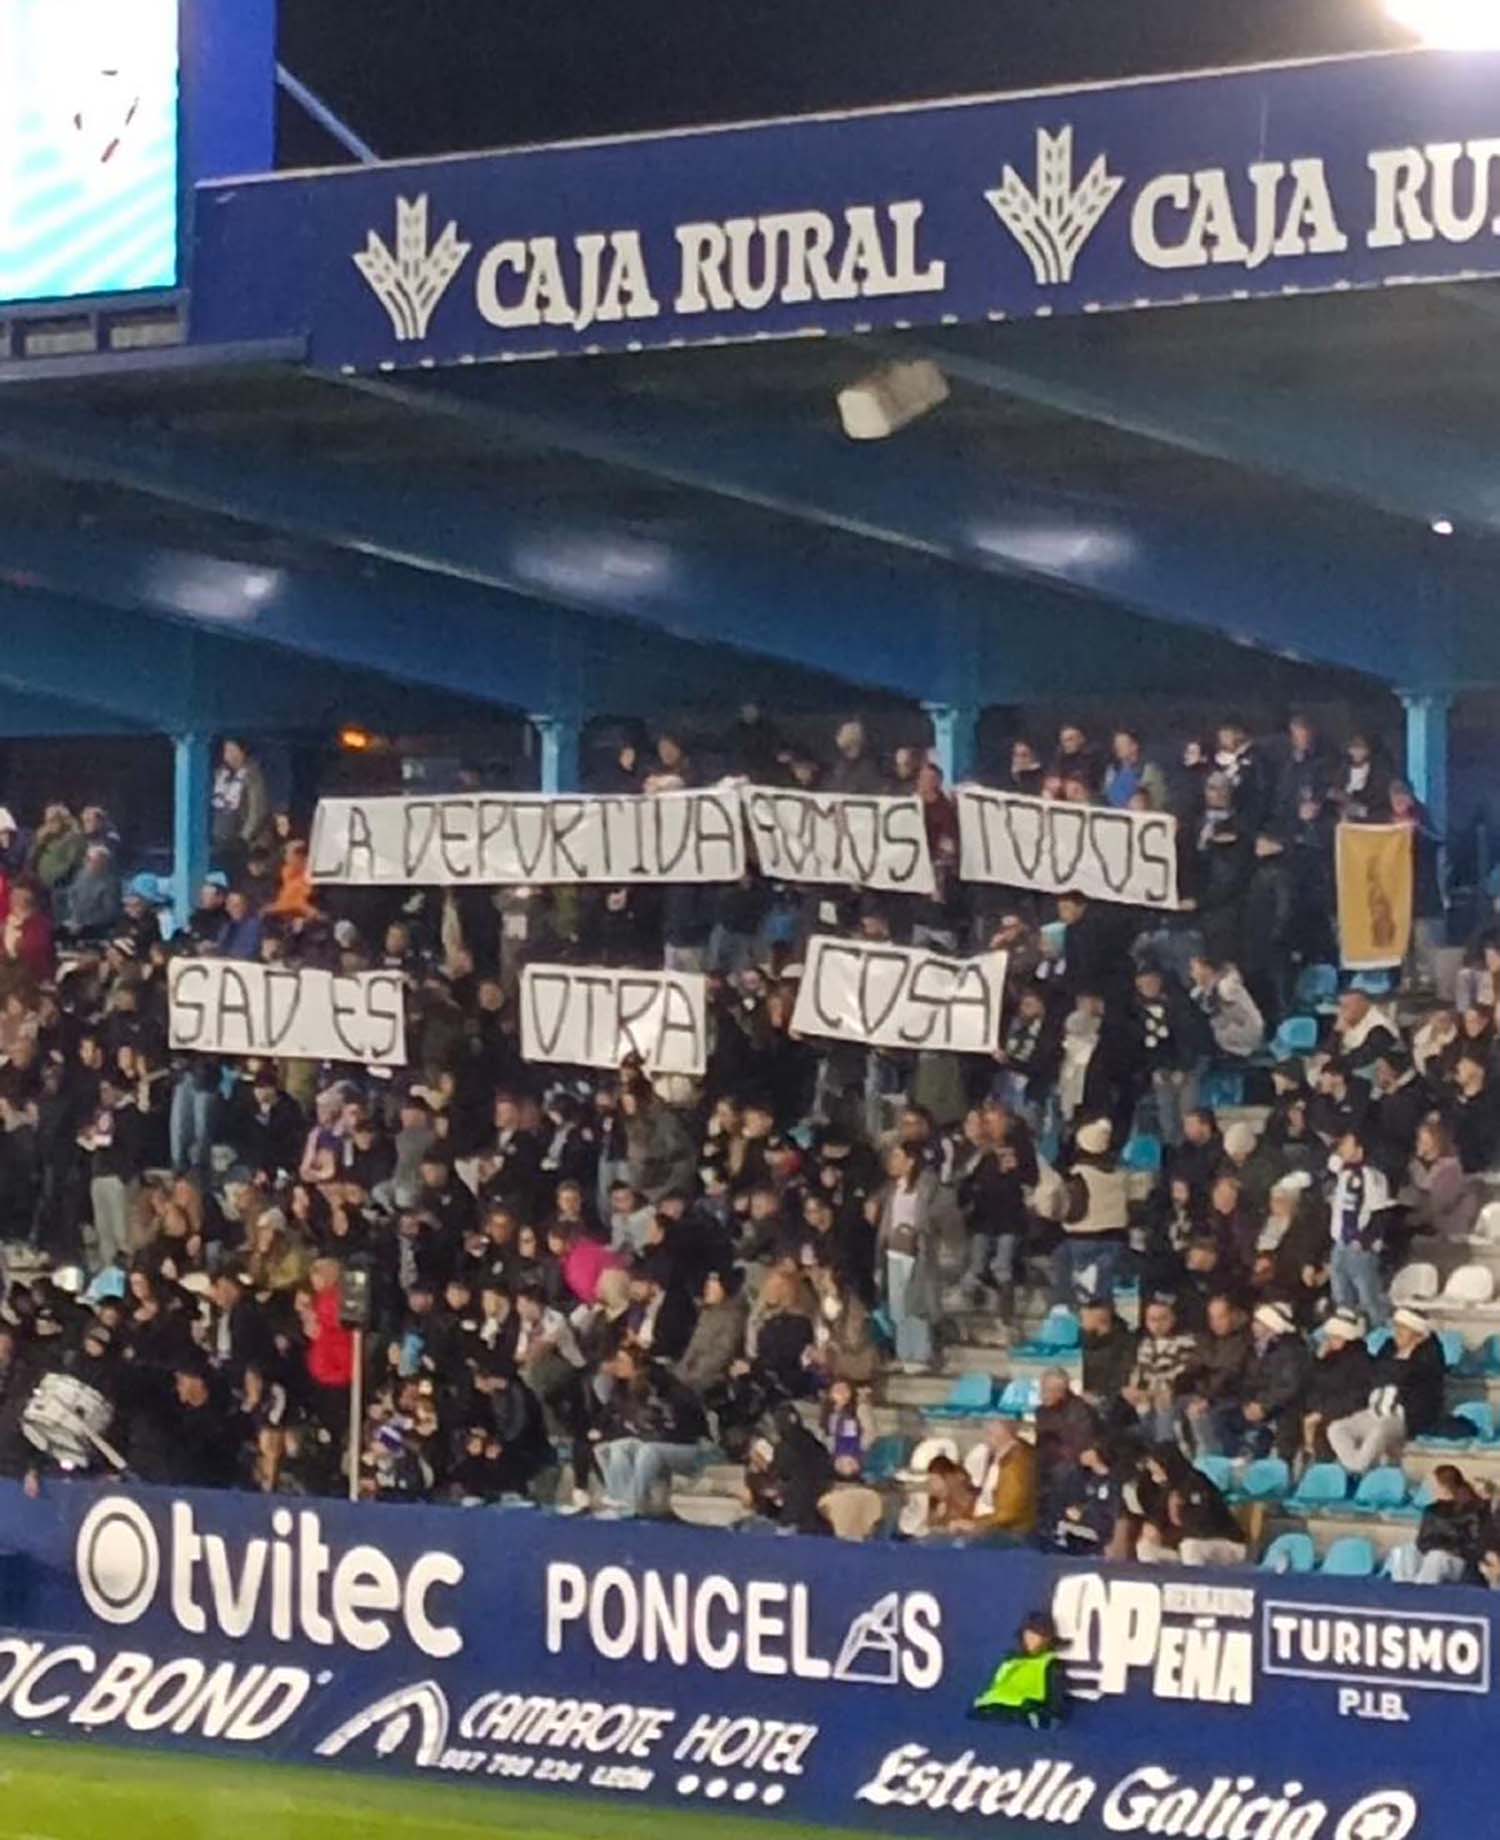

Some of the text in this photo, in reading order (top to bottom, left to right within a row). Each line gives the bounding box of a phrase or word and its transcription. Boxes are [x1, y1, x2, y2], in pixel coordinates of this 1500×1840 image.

[1131, 136, 1500, 269] CAJA RU
[477, 201, 945, 332] CAJA RURAL
[310, 795, 738, 879] LA DEPORTIVA
[964, 793, 1169, 901] TODOS
[328, 972, 398, 1059] ES
[529, 974, 700, 1069] OTRA
[813, 943, 992, 1045] COSA
[172, 1501, 464, 1659] tvitec
[546, 1562, 944, 1690] PONCELAS
[1271, 1614, 1480, 1676] TURISMO
[459, 1690, 819, 1776] CAMAROTE HOTEL
[856, 1742, 1328, 1840] Estrella Galicia
